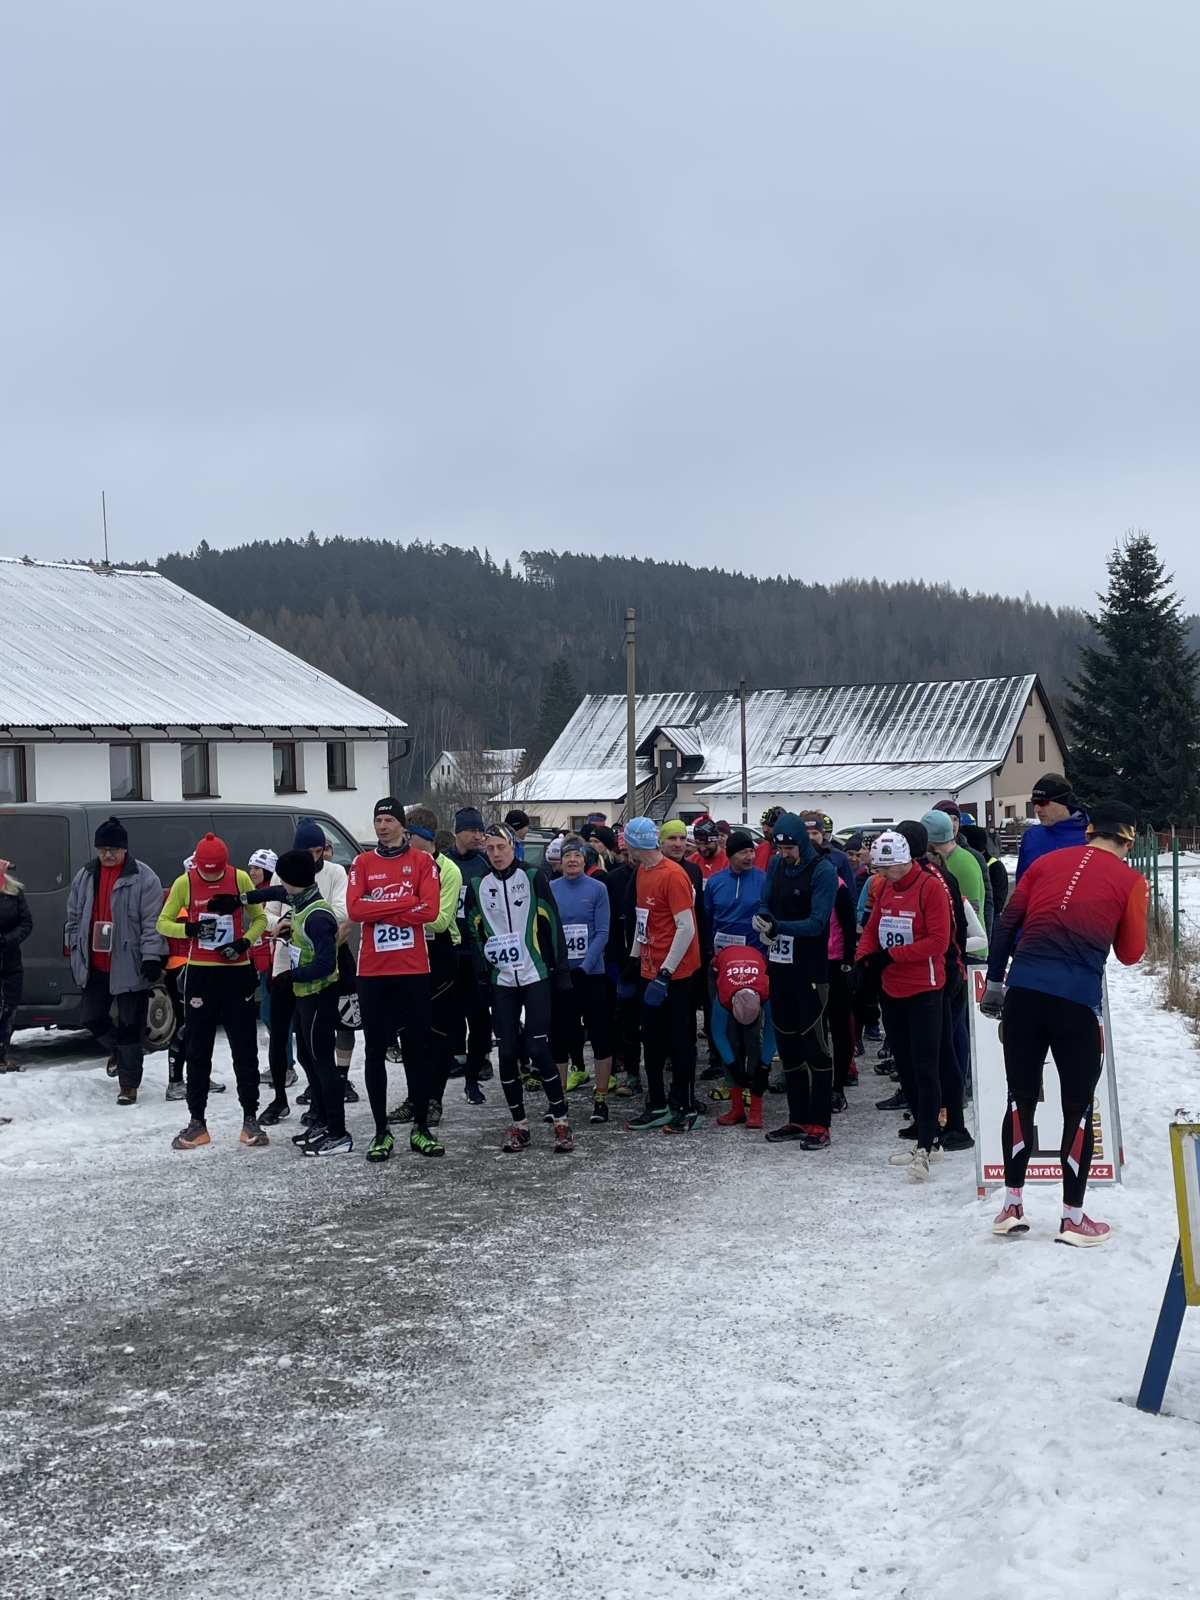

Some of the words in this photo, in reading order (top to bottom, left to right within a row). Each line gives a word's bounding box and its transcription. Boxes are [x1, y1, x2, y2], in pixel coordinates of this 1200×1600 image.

[1077, 849, 1094, 869] CZECH
[1060, 871, 1081, 911] REPUBLIC
[377, 926, 410, 943] 285
[886, 932, 905, 947] 89
[488, 947, 520, 964] 349
